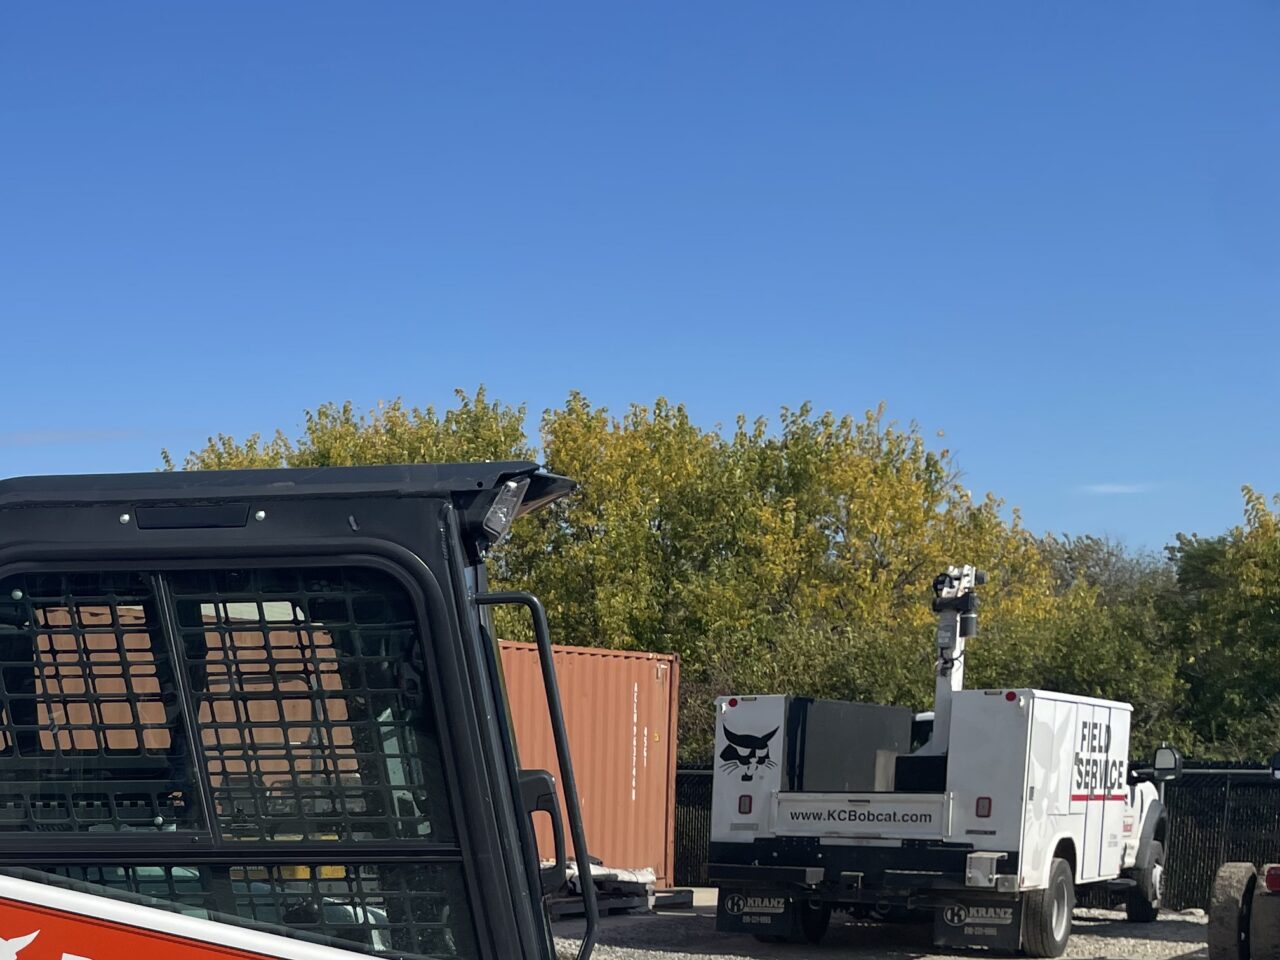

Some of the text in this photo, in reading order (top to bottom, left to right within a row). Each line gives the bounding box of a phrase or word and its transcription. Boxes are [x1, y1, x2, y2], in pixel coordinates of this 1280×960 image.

[1081, 721, 1111, 753] FIELD
[1075, 756, 1124, 790] SERVICE
[789, 809, 933, 823] www.KCBobcat.com
[747, 897, 785, 908] KRANZ
[969, 906, 1013, 918] KRANZ
